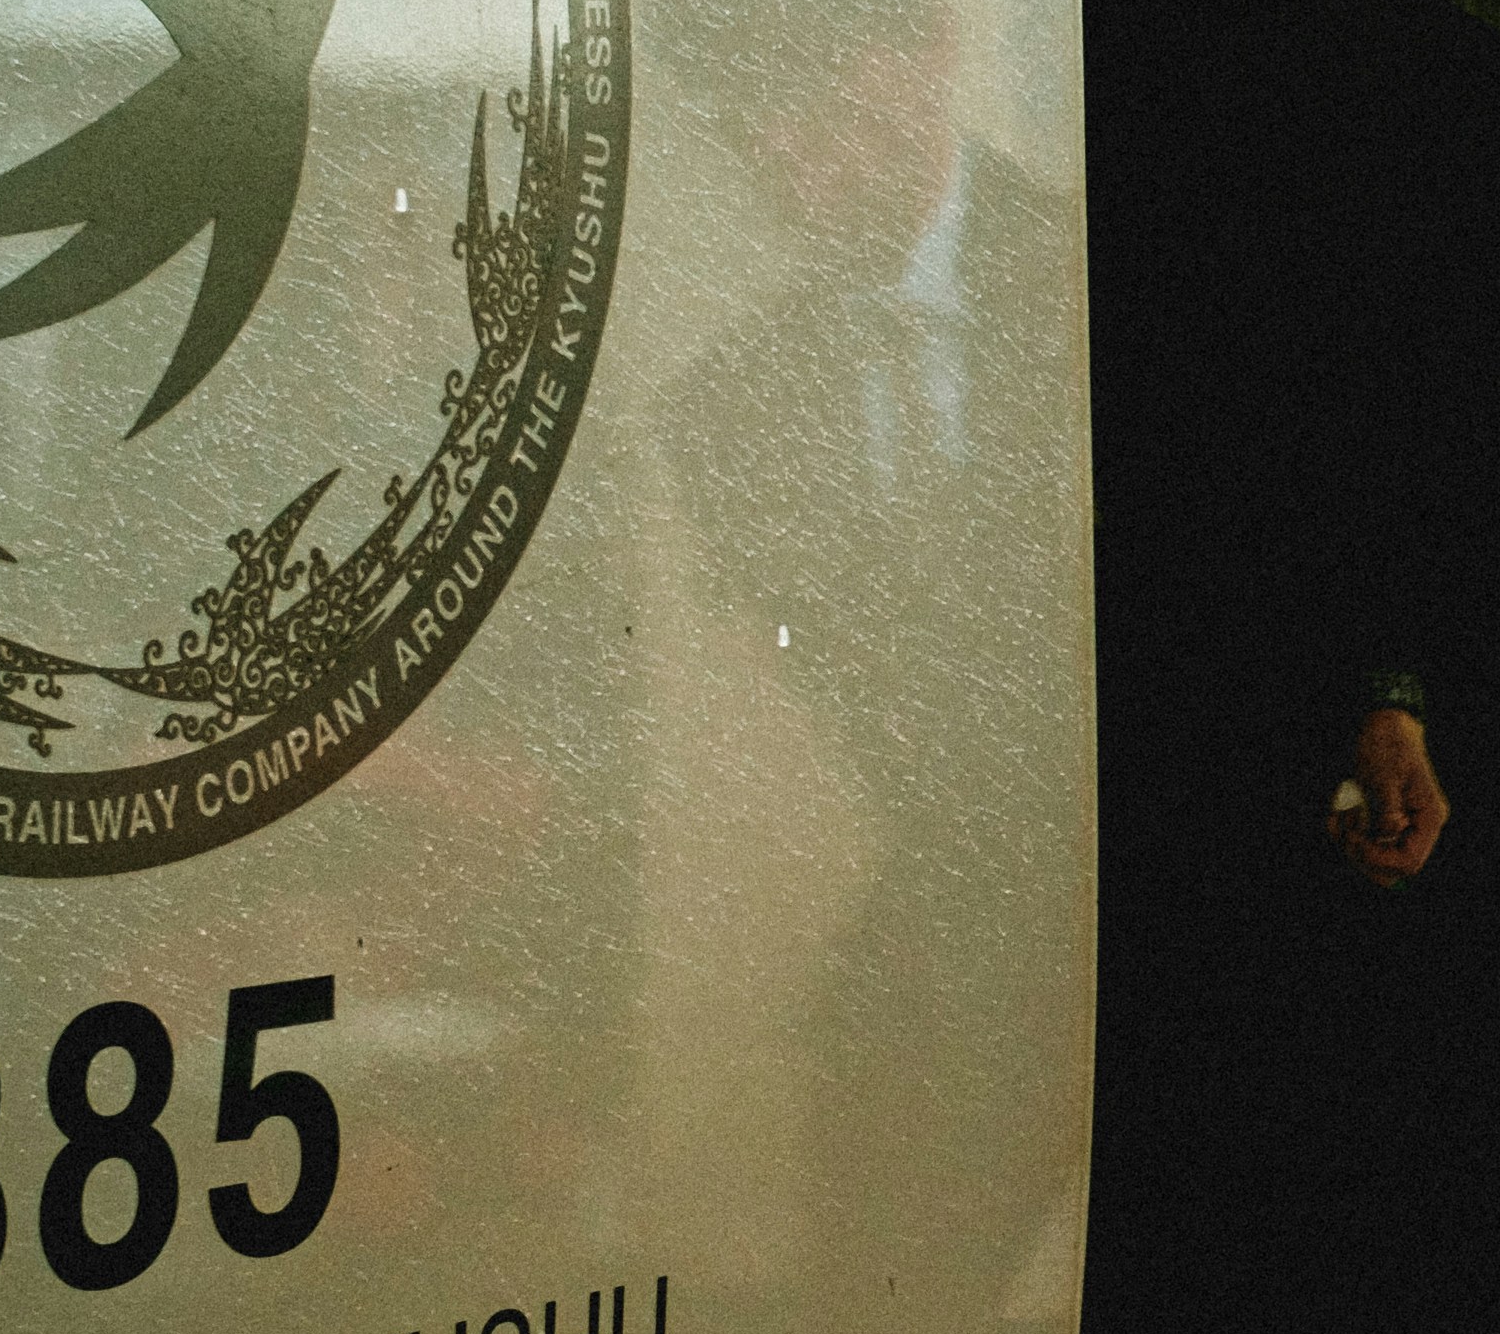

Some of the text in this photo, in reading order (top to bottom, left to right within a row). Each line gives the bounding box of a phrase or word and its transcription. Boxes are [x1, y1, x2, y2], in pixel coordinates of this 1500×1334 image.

[190, 662, 389, 817] COMPANY
[386, 478, 523, 678] AROUND
[507, 369, 567, 482] THE
[547, 131, 611, 363] KYUSHU
